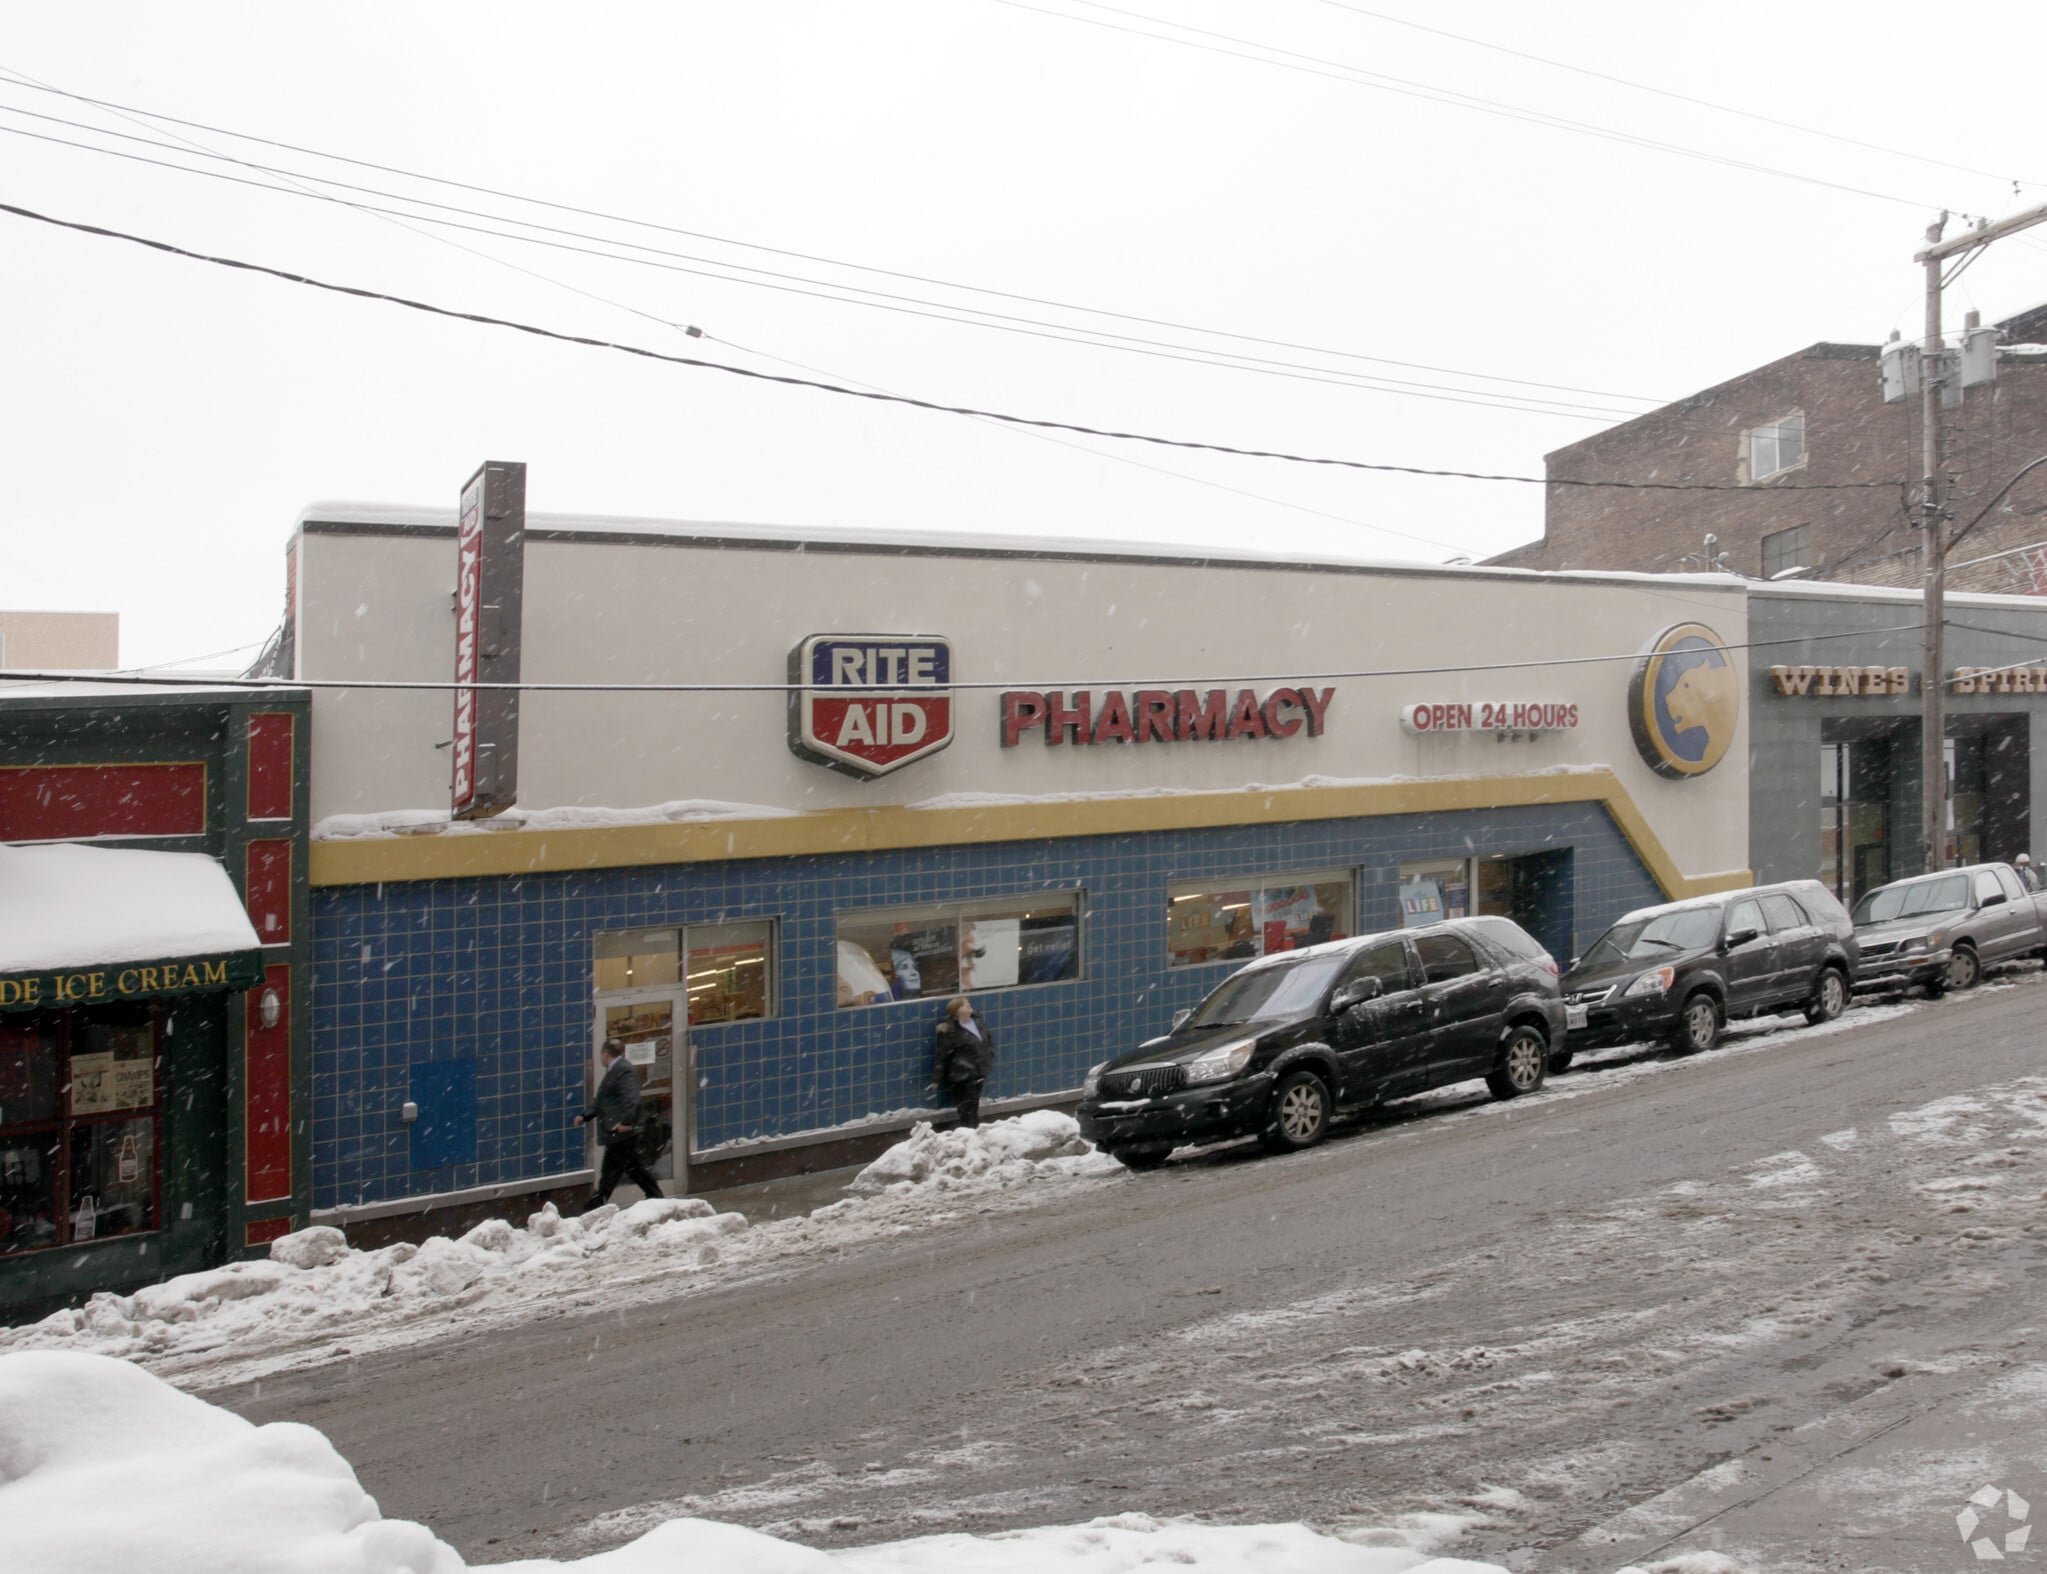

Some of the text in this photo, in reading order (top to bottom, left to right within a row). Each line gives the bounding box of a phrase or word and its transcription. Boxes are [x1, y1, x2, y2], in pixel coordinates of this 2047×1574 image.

[454, 547, 477, 799] PHARMACY
[832, 648, 936, 685] RITE
[1769, 666, 1909, 696] WINES
[836, 703, 927, 747] AID
[1001, 688, 1336, 747] PHARMACY
[1412, 702, 1579, 731] OPEN 24 HOURS
[1406, 896, 1438, 915] LIFE
[1027, 940, 1071, 955] get relief
[54, 971, 106, 1001] ICE
[117, 960, 228, 995] CREAM
